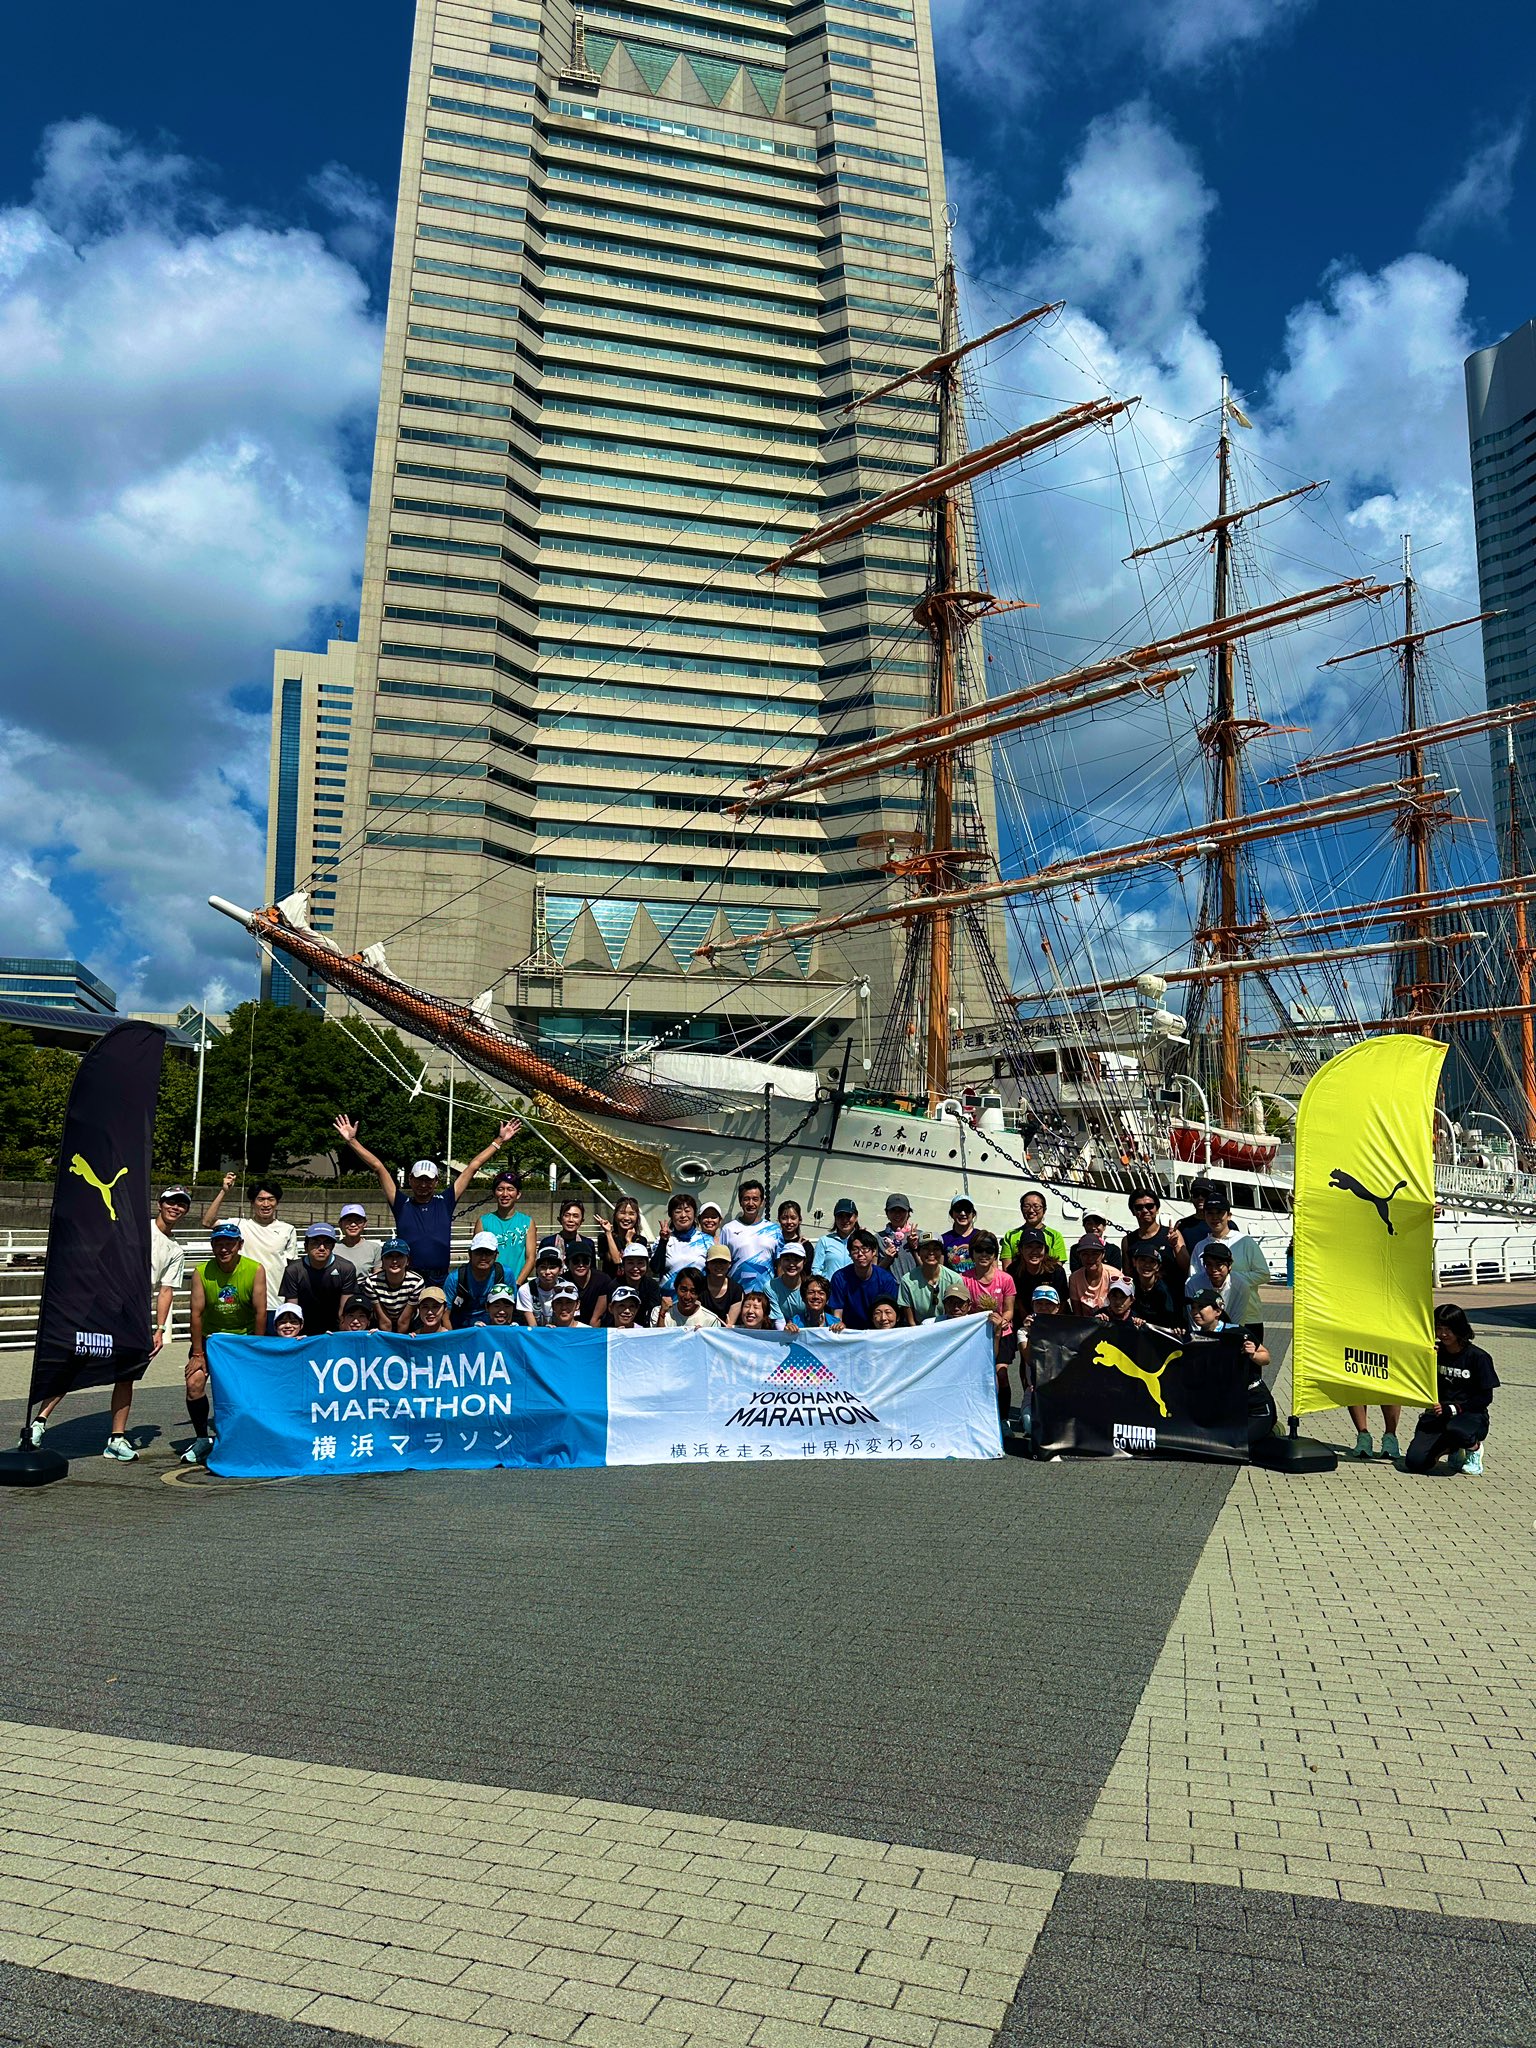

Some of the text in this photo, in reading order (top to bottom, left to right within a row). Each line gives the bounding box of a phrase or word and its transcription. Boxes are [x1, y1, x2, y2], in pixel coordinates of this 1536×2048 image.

[853, 1140, 938, 1158] NIPPON MARU
[76, 1331, 113, 1347] PUMA
[75, 1346, 112, 1359] GO WILD
[1344, 1347, 1388, 1368] PUMA
[308, 1351, 512, 1394] YOKOHAMA
[1345, 1361, 1388, 1380] GO WILD
[749, 1390, 861, 1405] YOKOHAMA
[311, 1393, 512, 1423] MARATHON
[725, 1405, 880, 1427] MARATHON
[1113, 1423, 1156, 1441] PUMA
[311, 1430, 513, 1461] 横浜マラソン
[1113, 1437, 1156, 1450] GO WILD
